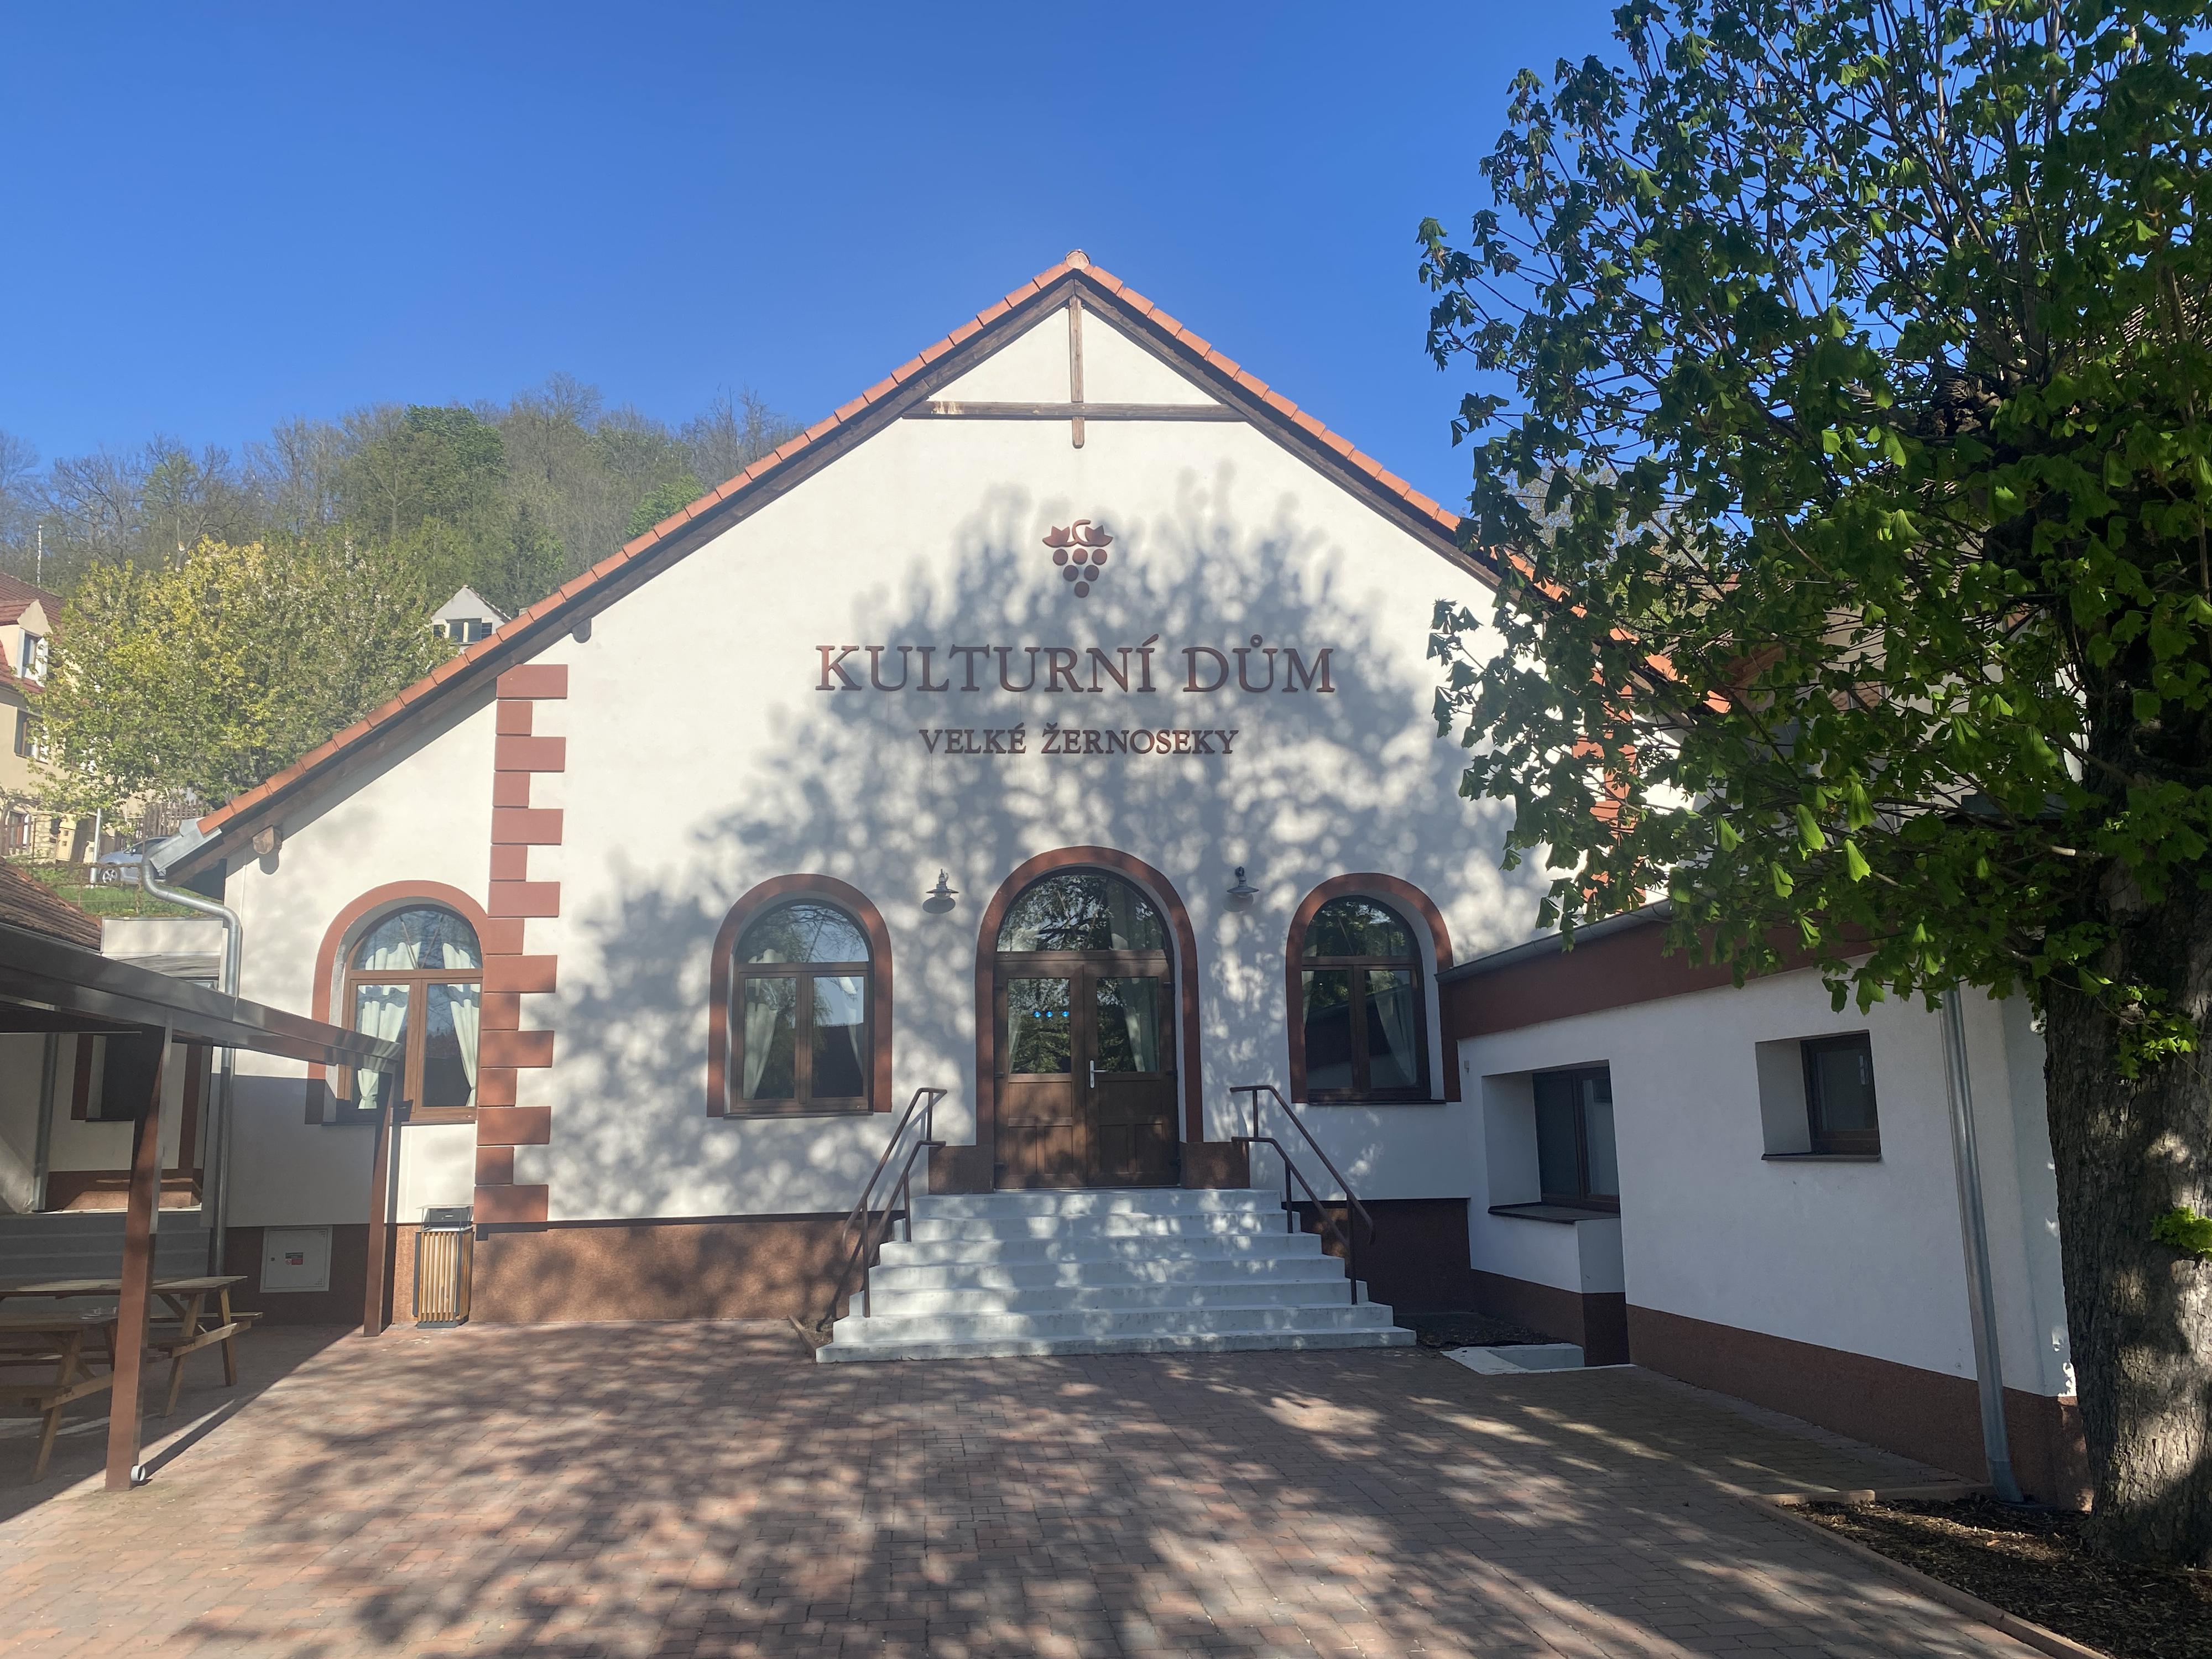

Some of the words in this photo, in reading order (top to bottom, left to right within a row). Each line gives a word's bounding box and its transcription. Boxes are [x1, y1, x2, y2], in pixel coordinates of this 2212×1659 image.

[815, 634, 1159, 692] KULTURNÍ
[1182, 634, 1335, 693] DŮM
[919, 723, 1026, 754] VELKÉ
[1041, 723, 1238, 754] ŽERNOSEKY
